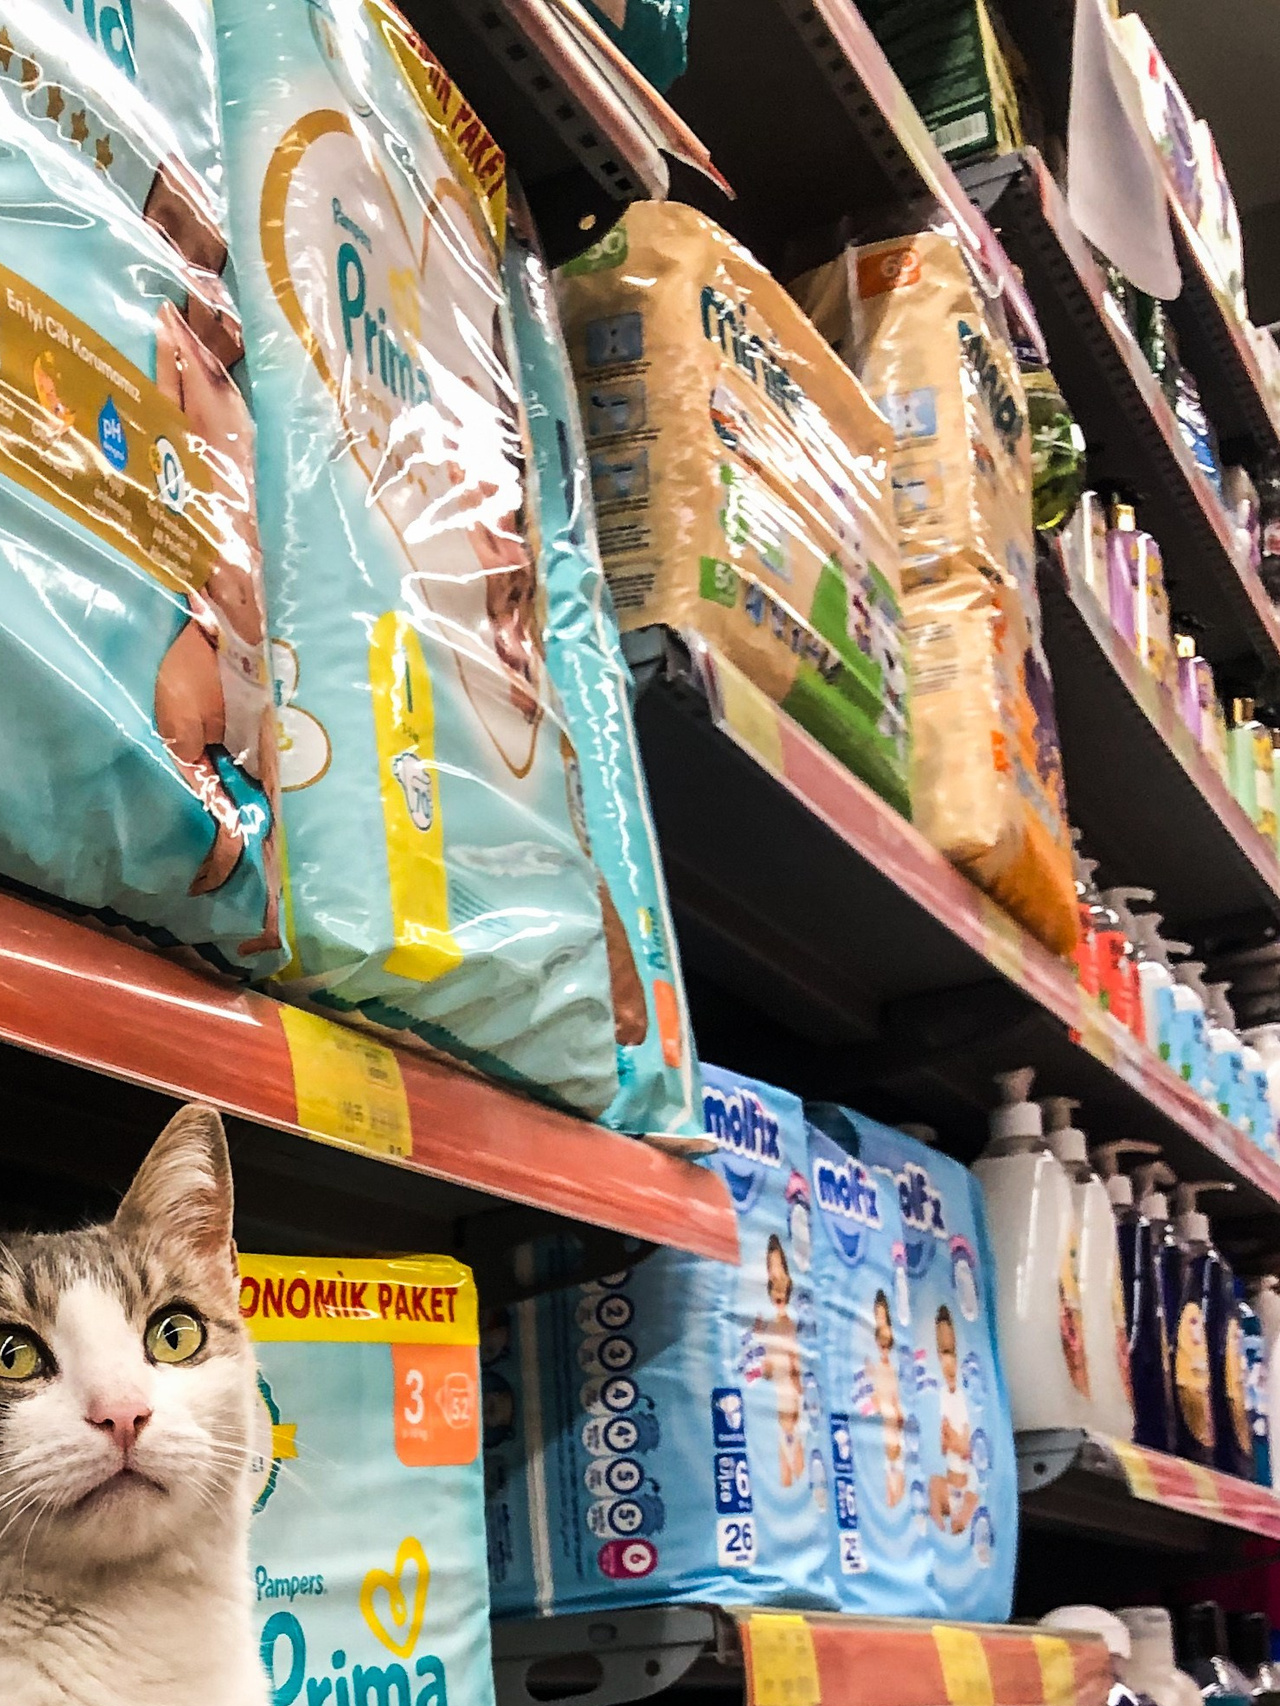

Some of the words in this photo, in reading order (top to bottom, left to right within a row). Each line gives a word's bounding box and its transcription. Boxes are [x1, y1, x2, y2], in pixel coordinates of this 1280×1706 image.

[703, 1095, 780, 1160] molfix
[818, 1163, 879, 1218] molfix
[897, 1171, 945, 1231] olfix
[239, 1270, 372, 1319] ONOMİK
[377, 1281, 459, 1324] PAKET
[403, 1369, 426, 1425] 3
[724, 1523, 753, 1553] 26
[255, 1565, 325, 1603] Pampers
